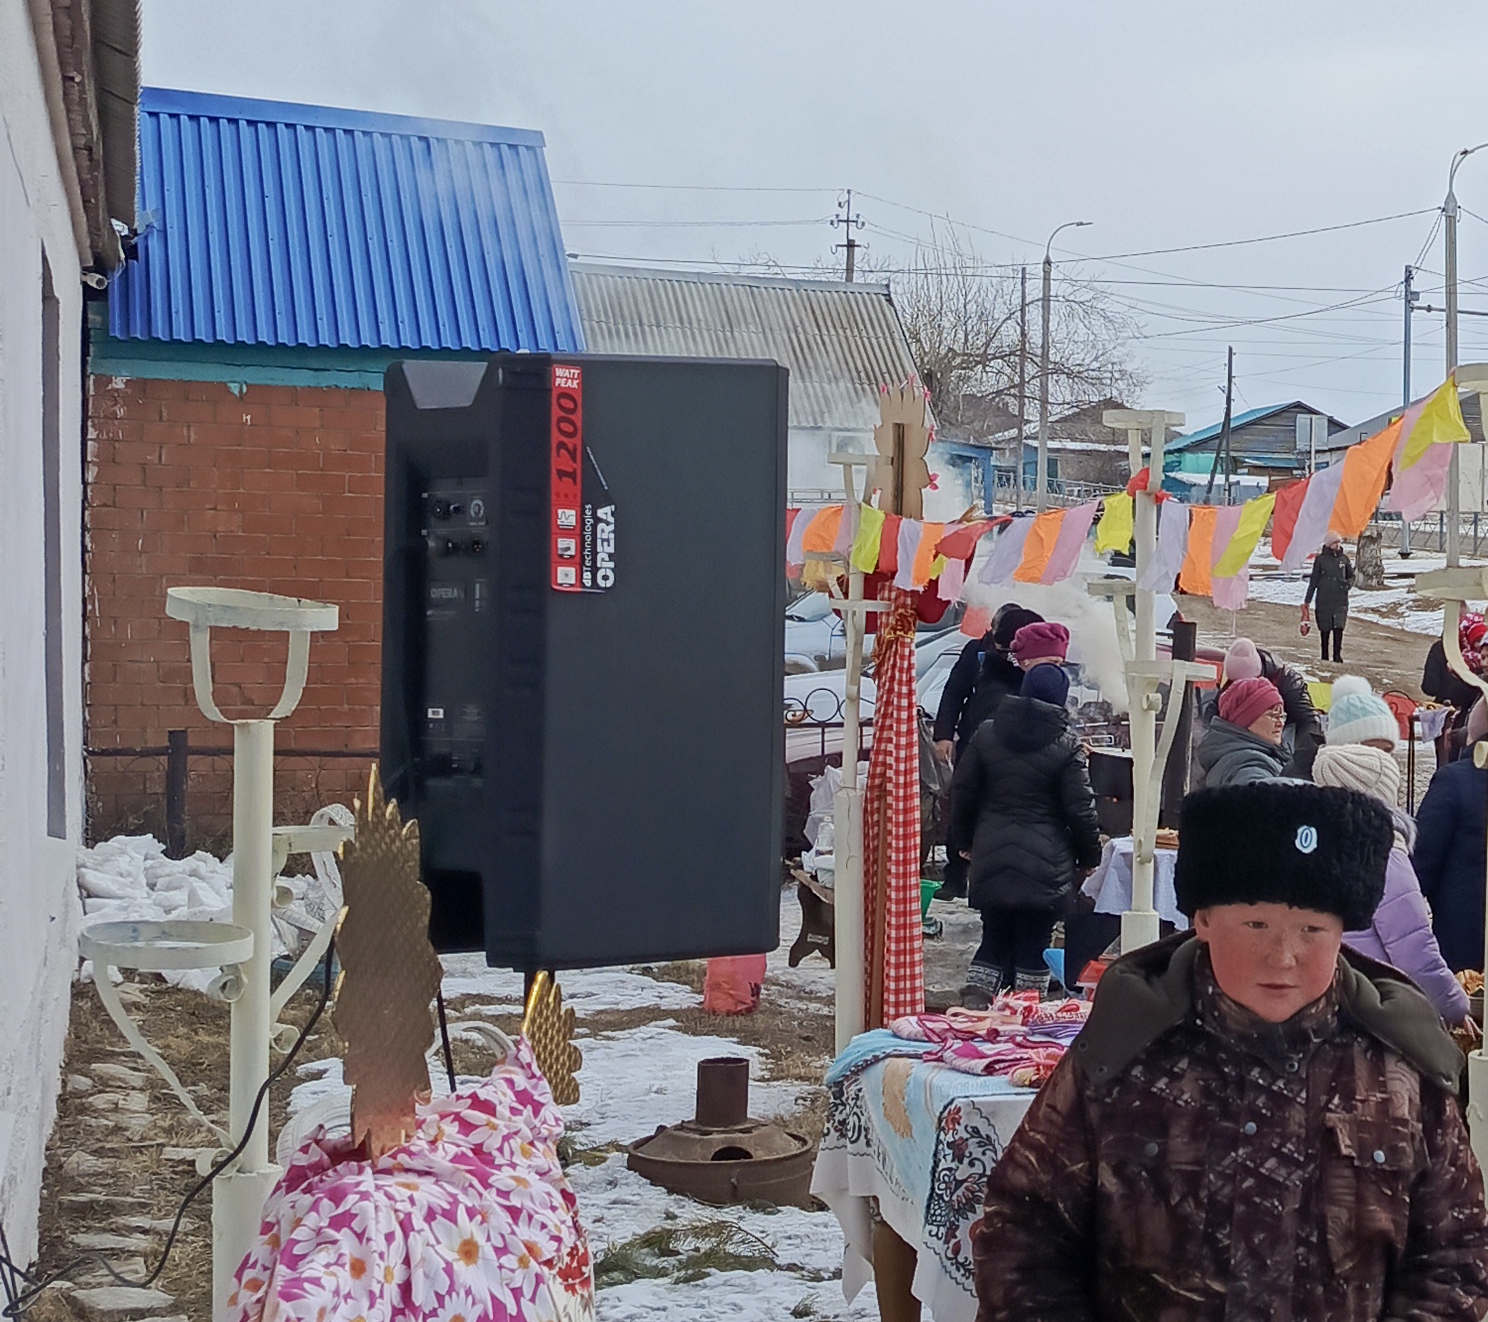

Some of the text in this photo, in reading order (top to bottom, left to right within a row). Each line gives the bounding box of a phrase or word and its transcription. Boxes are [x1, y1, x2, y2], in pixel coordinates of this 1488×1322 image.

[555, 367, 580, 379] WATT
[555, 378, 579, 389] PEAK
[556, 391, 578, 487] 1200
[582, 503, 594, 588] dBTechnologies
[596, 504, 616, 588] OPERA
